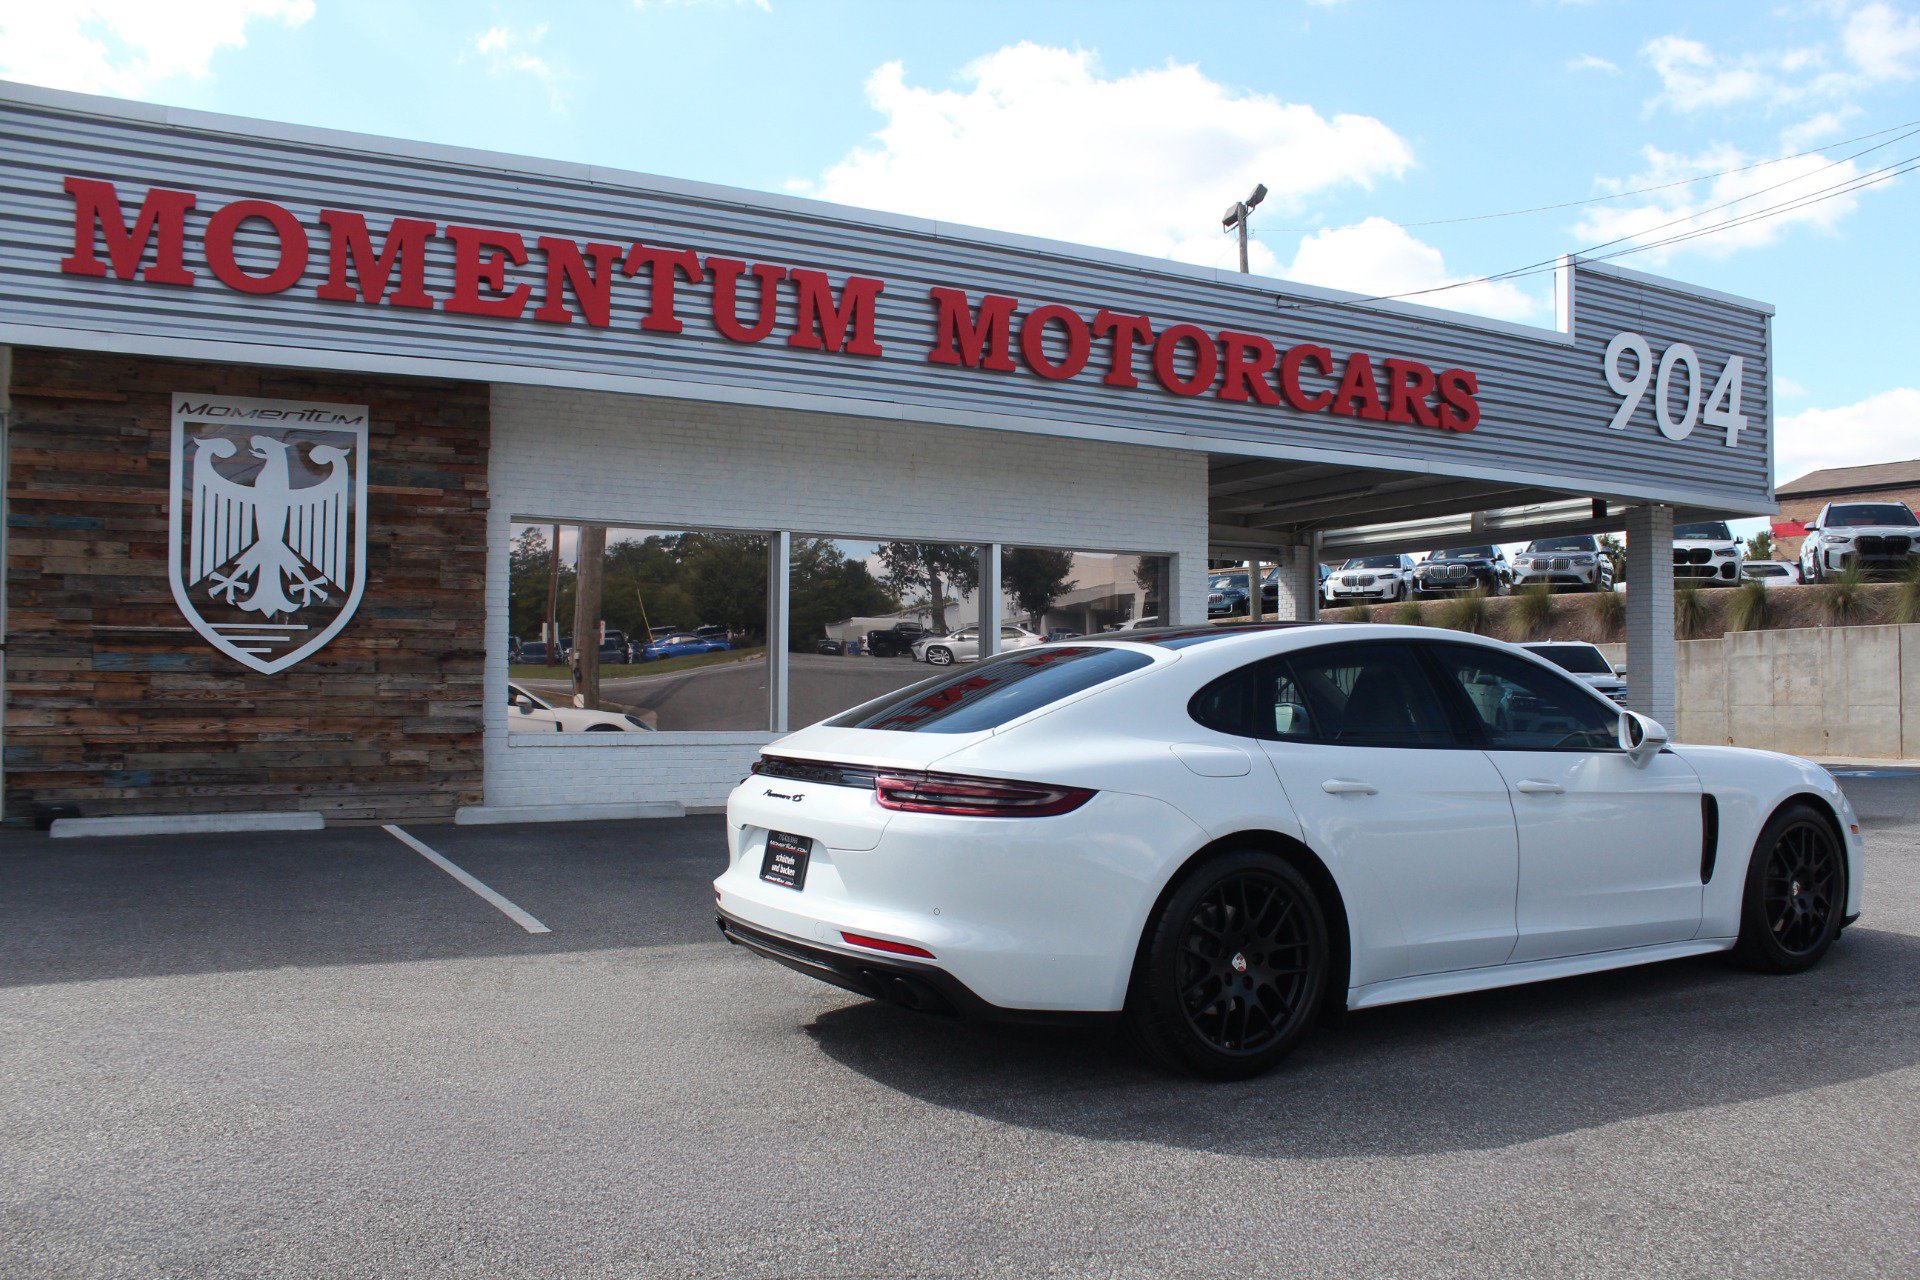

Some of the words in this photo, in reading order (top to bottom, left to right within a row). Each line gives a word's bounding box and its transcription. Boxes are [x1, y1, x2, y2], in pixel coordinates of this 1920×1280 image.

[61, 176, 885, 356] MOMENTUM
[928, 286, 1482, 433] MOTORCARS
[1603, 331, 1748, 448] 904
